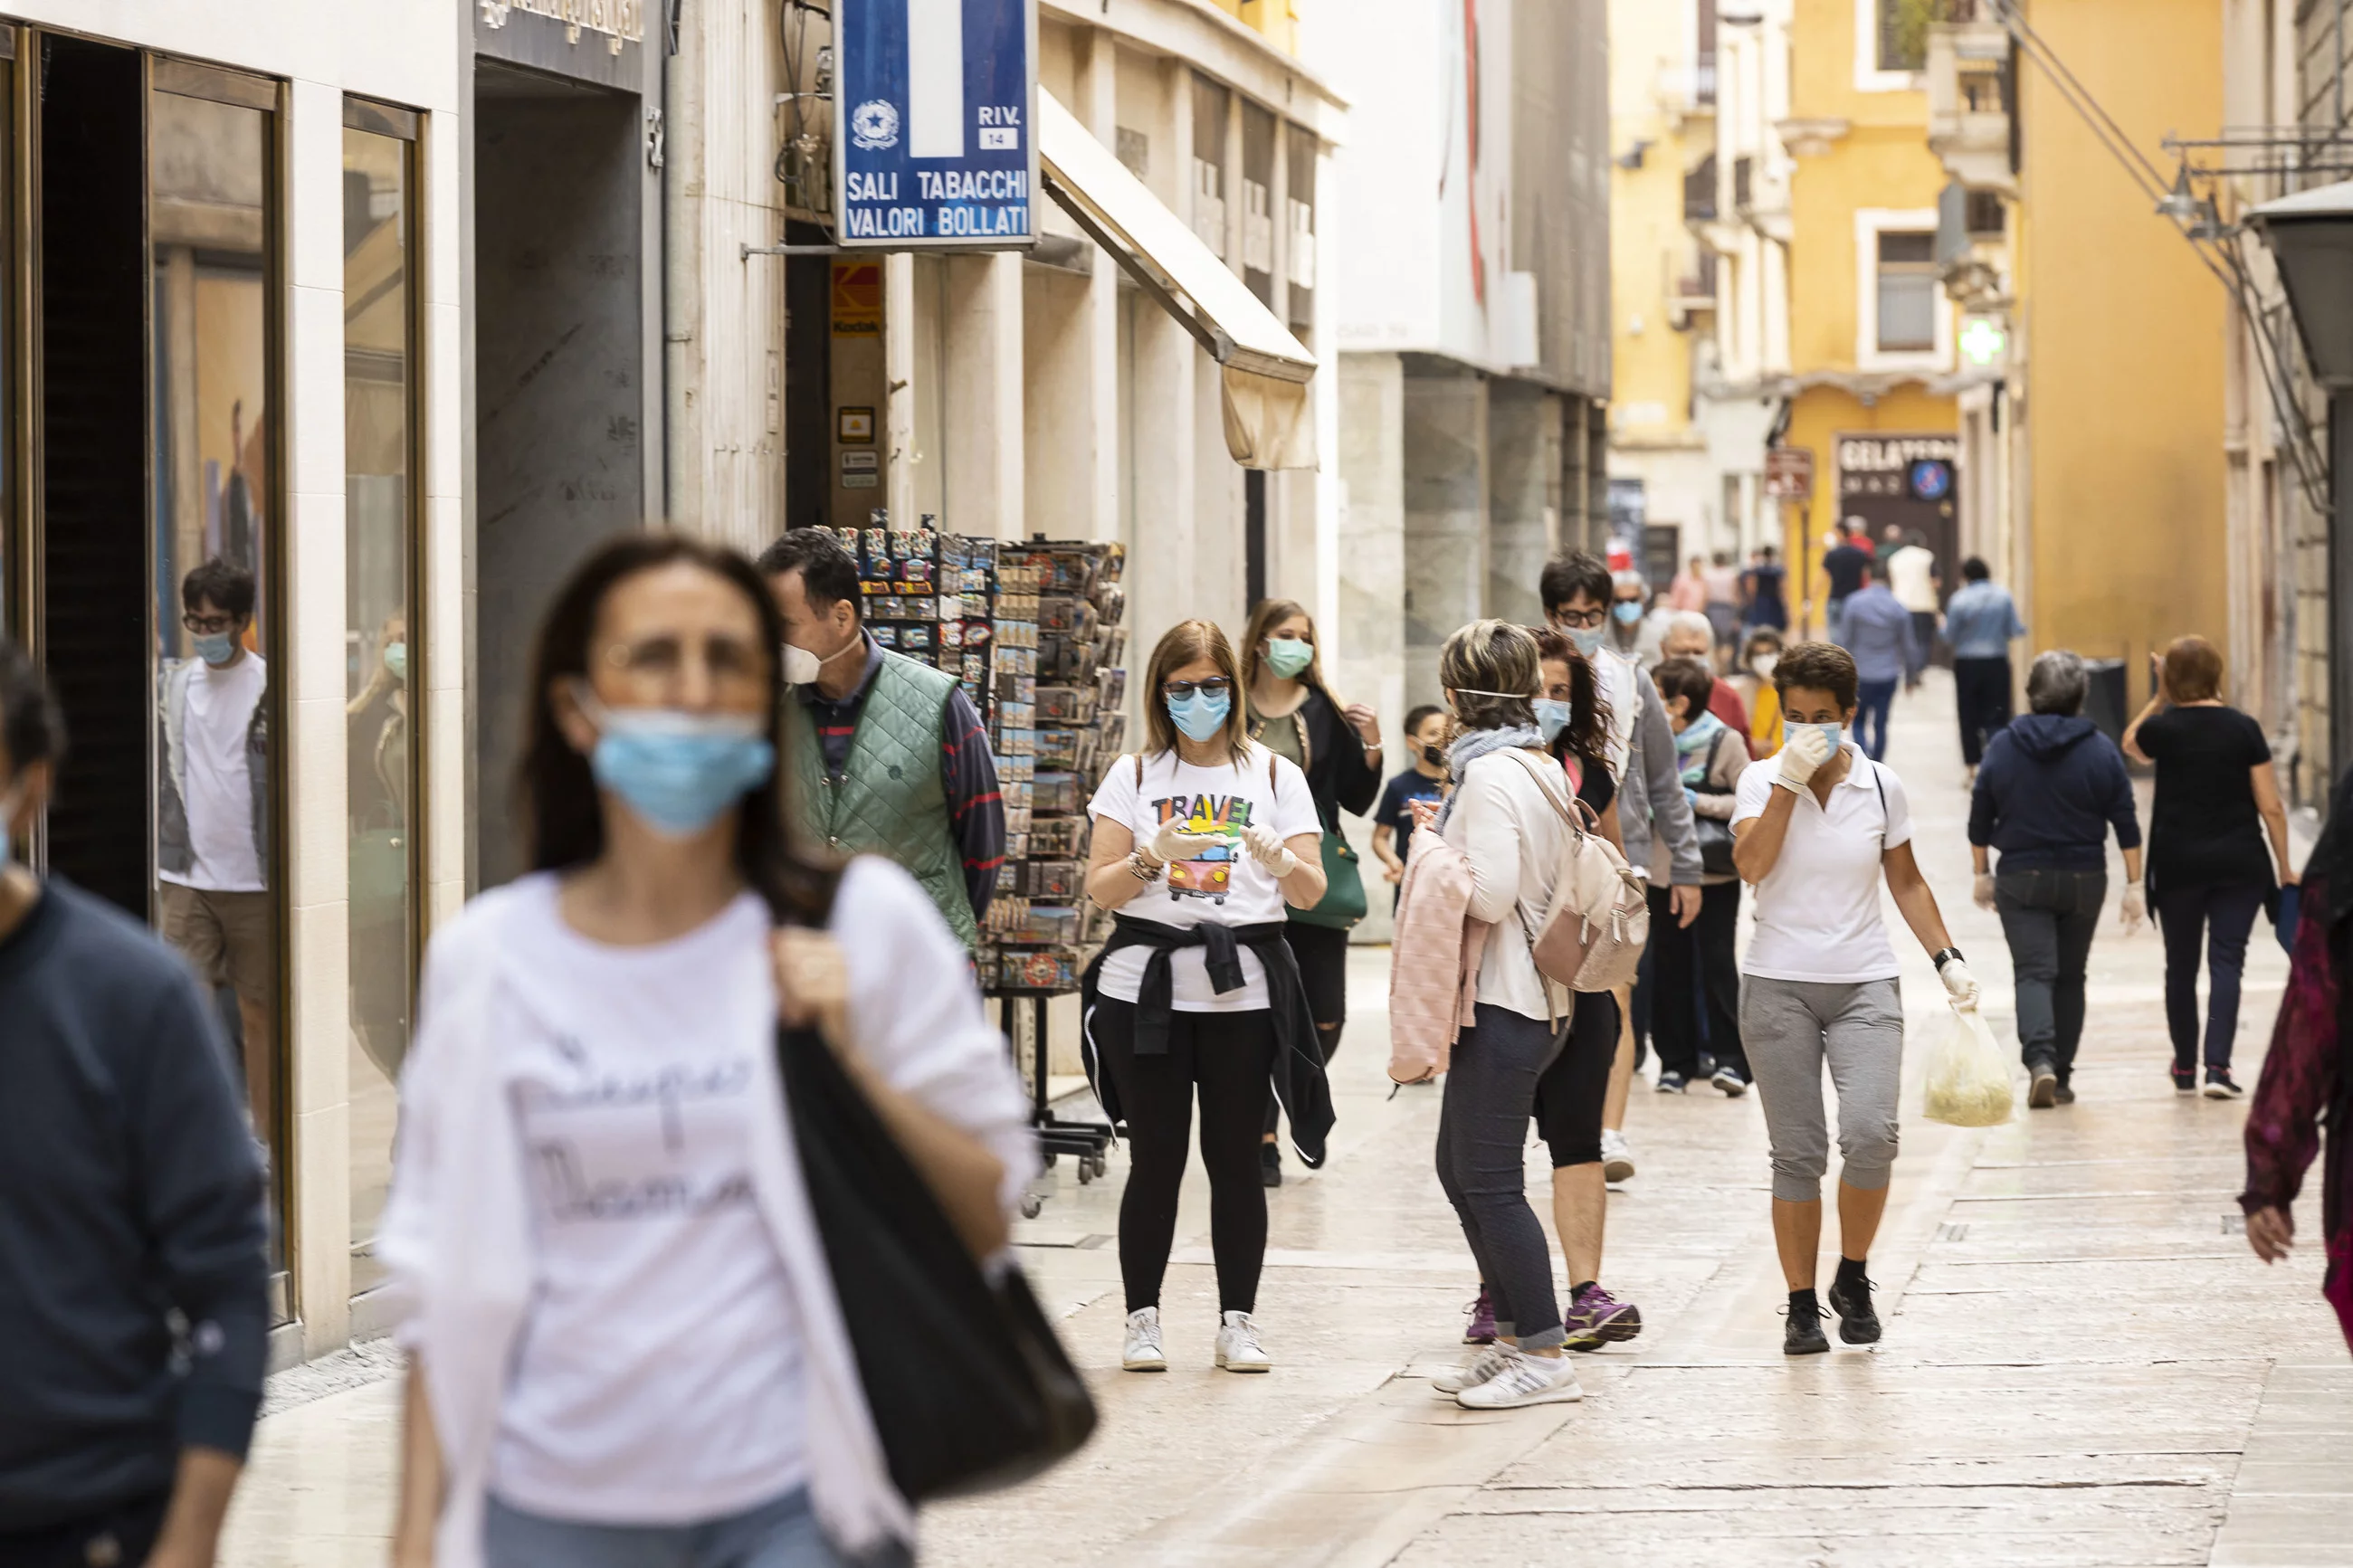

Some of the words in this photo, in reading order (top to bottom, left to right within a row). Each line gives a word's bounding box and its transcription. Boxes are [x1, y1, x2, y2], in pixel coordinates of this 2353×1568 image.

[978, 106, 1021, 126] RIV.
[988, 133, 1005, 146] 14
[846, 172, 898, 202] SALI
[917, 170, 1027, 200] TABACCHI
[847, 208, 924, 237] VALORI
[938, 206, 1028, 236] BOLLATI
[834, 319, 880, 333] Kodak
[1151, 794, 1255, 829] TRAVEL
